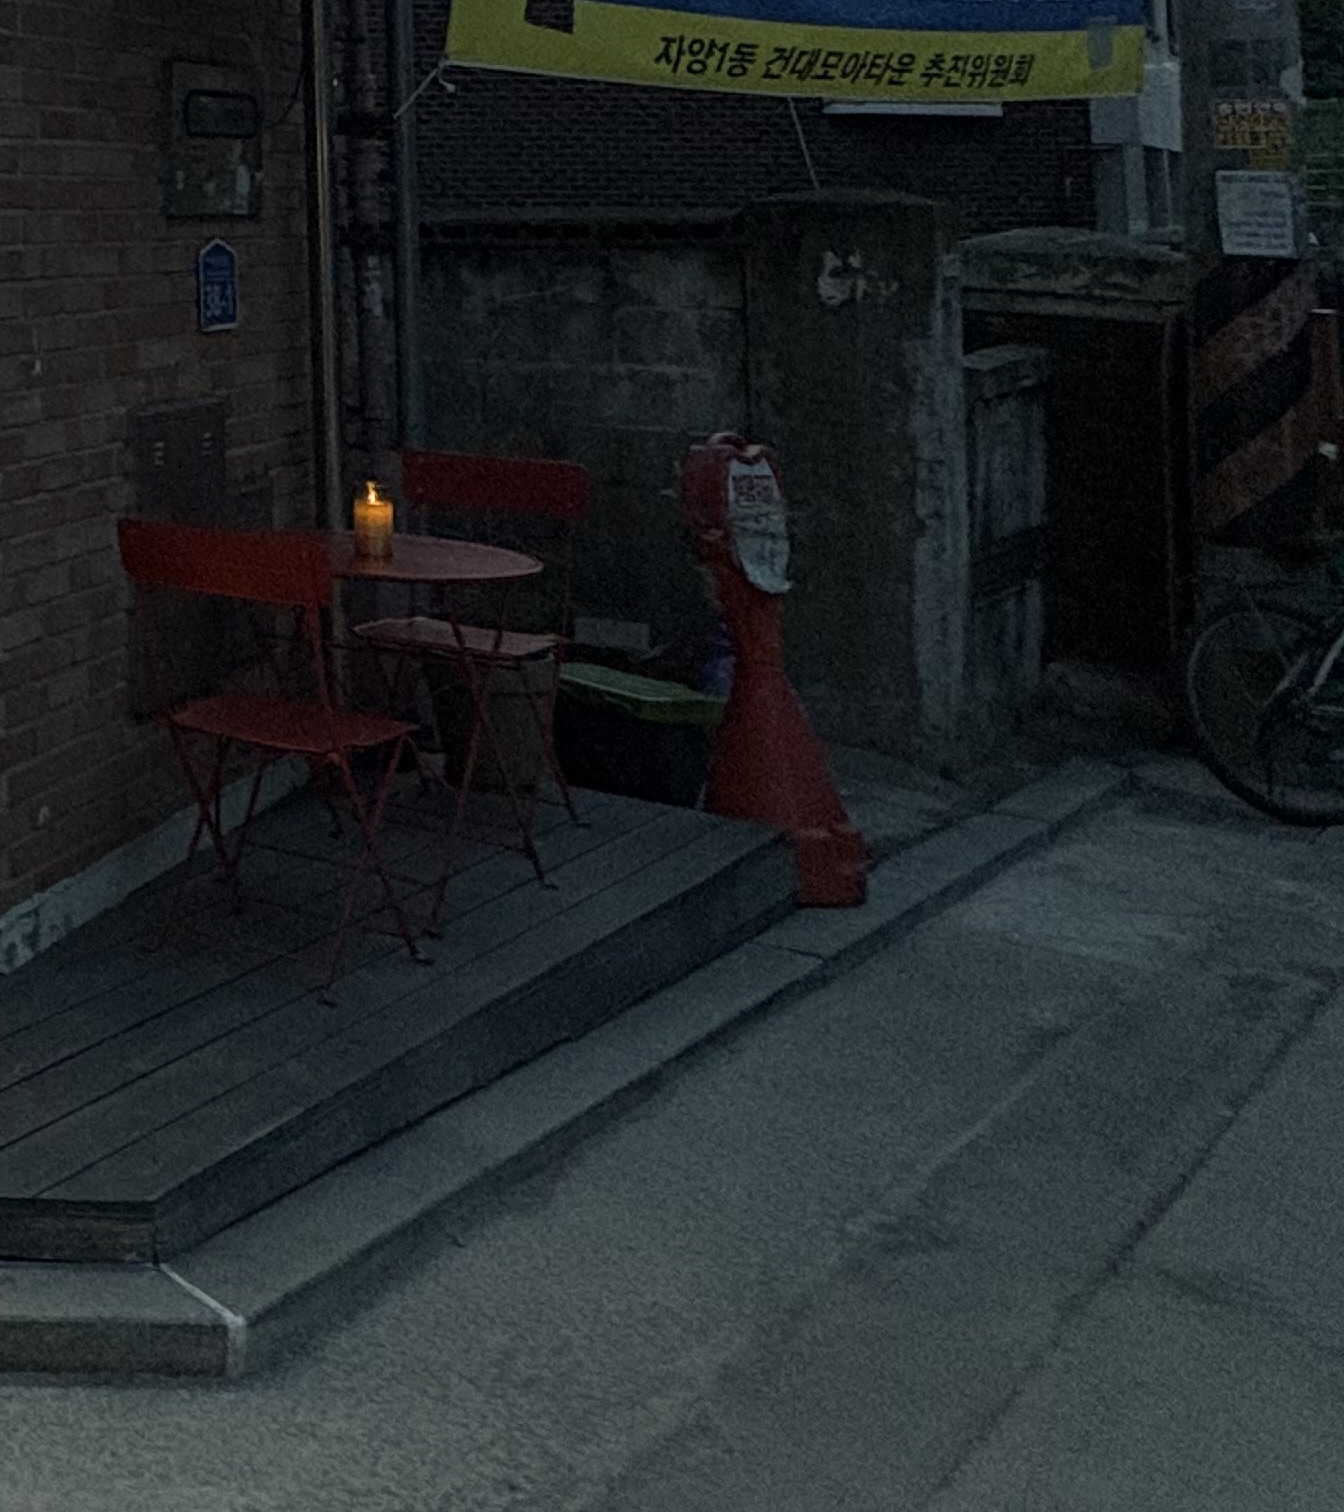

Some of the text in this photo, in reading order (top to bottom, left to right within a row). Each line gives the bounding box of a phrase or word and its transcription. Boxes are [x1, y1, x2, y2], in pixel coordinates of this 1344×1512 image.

[654, 34, 1034, 88] 자양1동 건대모아타운 추진위원회
